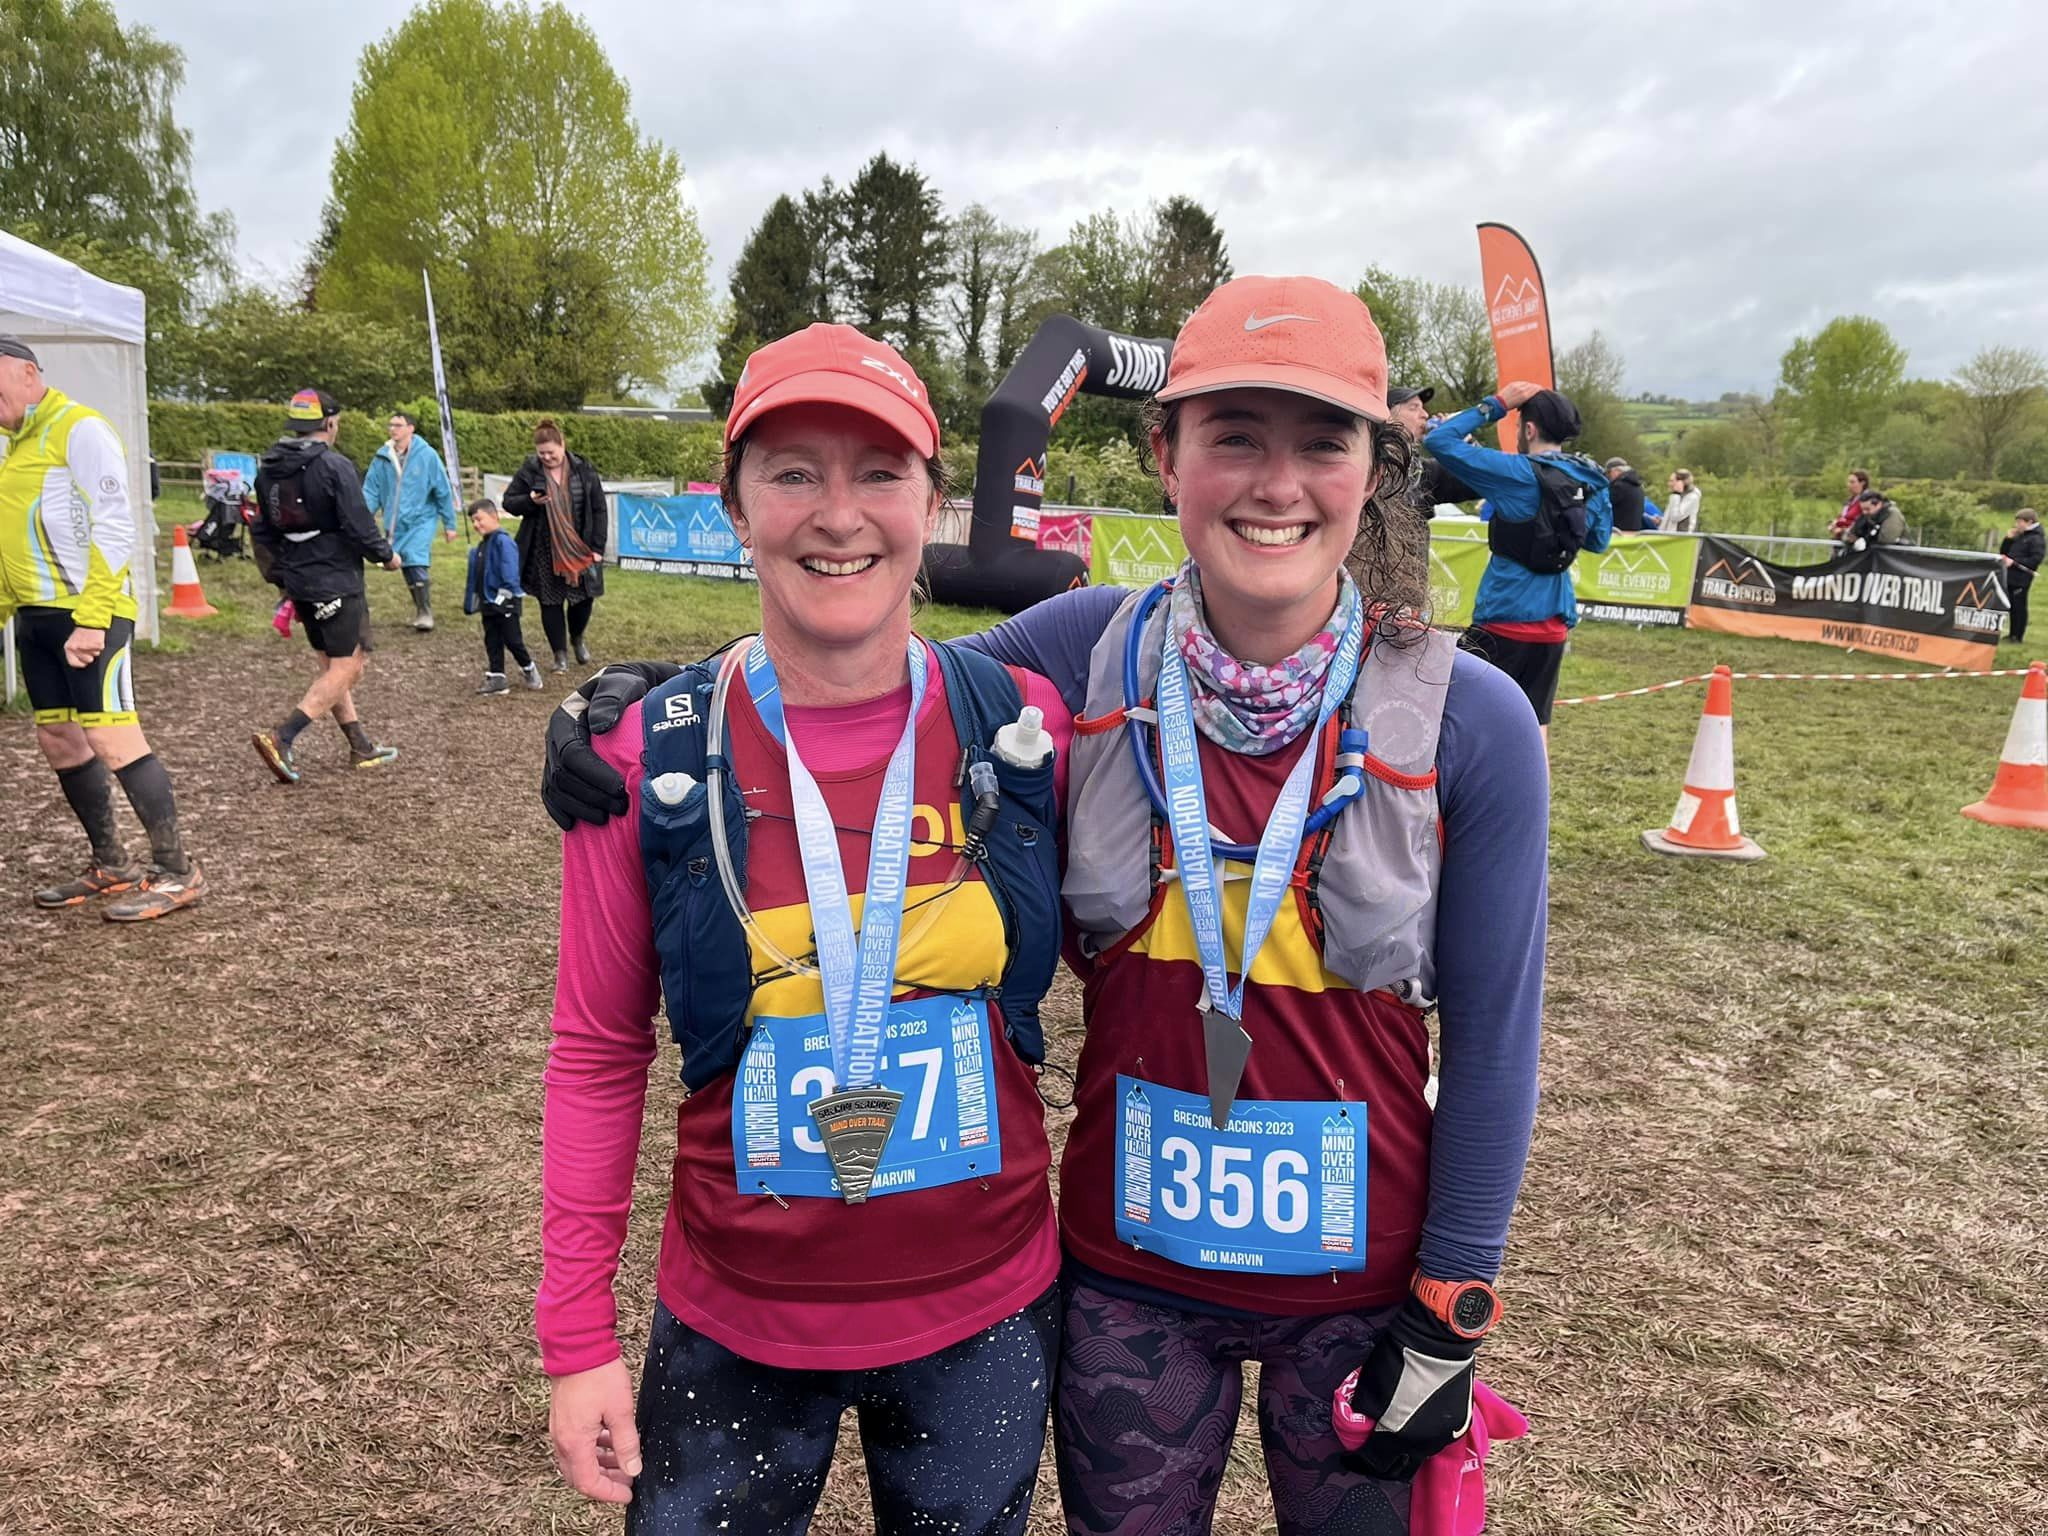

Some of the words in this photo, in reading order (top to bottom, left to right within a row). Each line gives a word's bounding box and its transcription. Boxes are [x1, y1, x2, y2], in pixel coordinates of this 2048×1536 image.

[1105, 335, 1166, 392] START
[1109, 560, 1130, 577] TRAIL
[1132, 561, 1162, 580] EVENTS
[1598, 571, 1620, 586] TRAIL
[1623, 574, 1657, 590] EVENTS
[1658, 575, 1671, 592] CO
[1703, 579, 1726, 597] TRAIL
[1727, 582, 1762, 603] EVENTS
[1763, 589, 1776, 604] CO
[1792, 573, 1862, 602] MIND
[1903, 577, 1946, 615] TRAIL
[1593, 605, 1624, 620] ULTRA
[1624, 607, 1680, 625] MARATHON
[1163, 711, 1188, 729] 2023
[1166, 738, 1192, 754] OVER
[1168, 750, 1194, 766] MIND
[886, 783, 908, 795] 2023
[1171, 784, 1211, 891] MARATHON
[1256, 795, 1304, 900] MARATHON
[801, 802, 843, 909] MARATHON
[870, 795, 907, 903] MARATHON
[1189, 890, 1213, 905] 2023
[866, 924, 893, 938] MIND
[1195, 918, 1216, 931] OVER
[822, 930, 848, 945] MIND
[865, 938, 892, 950] OVER
[824, 943, 850, 958] OVER
[828, 970, 855, 986] 2023
[861, 964, 889, 980] 2023
[804, 1035, 831, 1052] BREC
[900, 1020, 928, 1037] 2023
[846, 979, 887, 1091] MARATHON
[951, 1022, 979, 1043] MIND
[953, 1038, 981, 1059] OVER
[746, 1050, 776, 1068] MIND
[955, 1054, 984, 1076] TRAIL
[744, 1067, 776, 1085] OVER
[744, 1084, 777, 1102] TRAIL
[790, 1047, 944, 1155] 37
[956, 1072, 988, 1128] MARATHON
[744, 1103, 780, 1151] MARATHON
[830, 1119, 849, 1133] MIND
[848, 1117, 867, 1128] OVER
[867, 1116, 886, 1128] TRAIL
[1125, 1106, 1151, 1128] MIND
[1173, 1109, 1213, 1130] BRECON
[1214, 1118, 1263, 1136] ACONS
[1265, 1121, 1294, 1136] 2023
[1125, 1122, 1151, 1142] OVER
[1125, 1137, 1151, 1157] TRAIL
[1322, 1135, 1355, 1151] MIND
[1321, 1151, 1355, 1167] OVER
[872, 1168, 916, 1190] MARVIN
[1124, 1154, 1151, 1207] MARATHON
[1160, 1136, 1309, 1234] 356
[1321, 1167, 1355, 1183] TRAIL
[1321, 1183, 1355, 1235] MARATHON
[1200, 1249, 1218, 1263] MO
[1219, 1251, 1264, 1267] MARVIN
